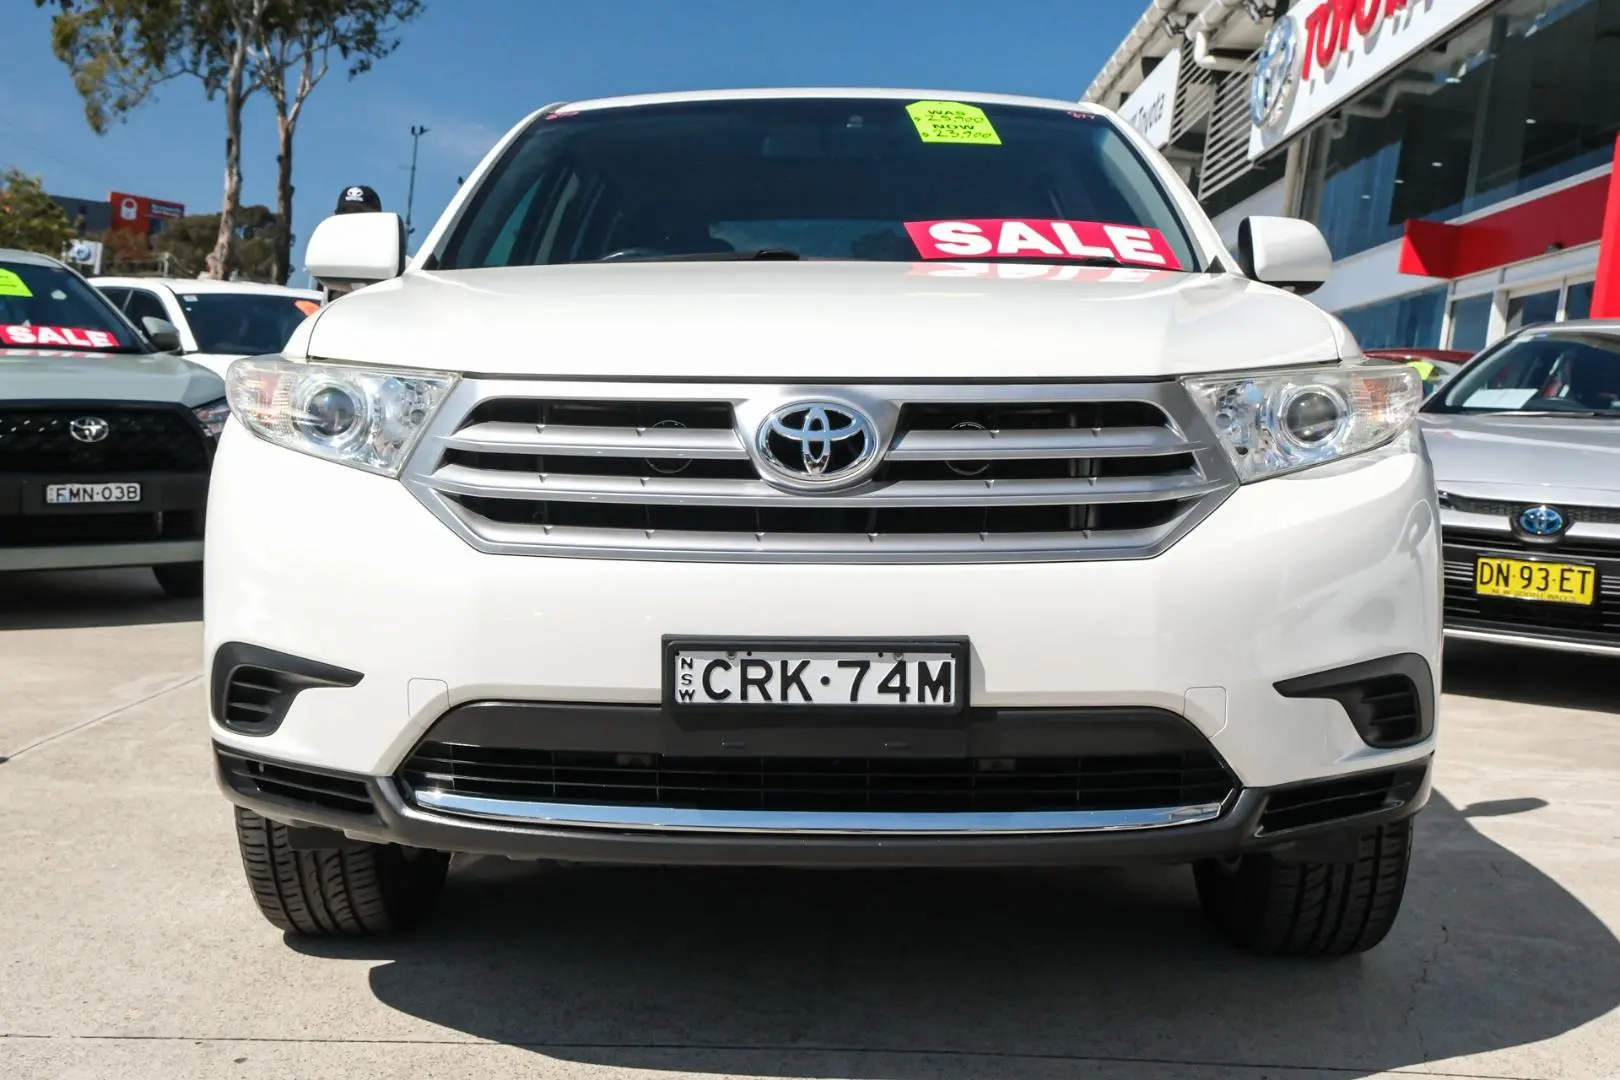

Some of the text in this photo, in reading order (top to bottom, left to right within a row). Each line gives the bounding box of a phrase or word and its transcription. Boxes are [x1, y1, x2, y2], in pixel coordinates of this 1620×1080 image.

[1302, 0, 1408, 81] TOYO
[928, 221, 1166, 264] SALE
[5, 325, 113, 347] SALE
[679, 657, 695, 701] NSW
